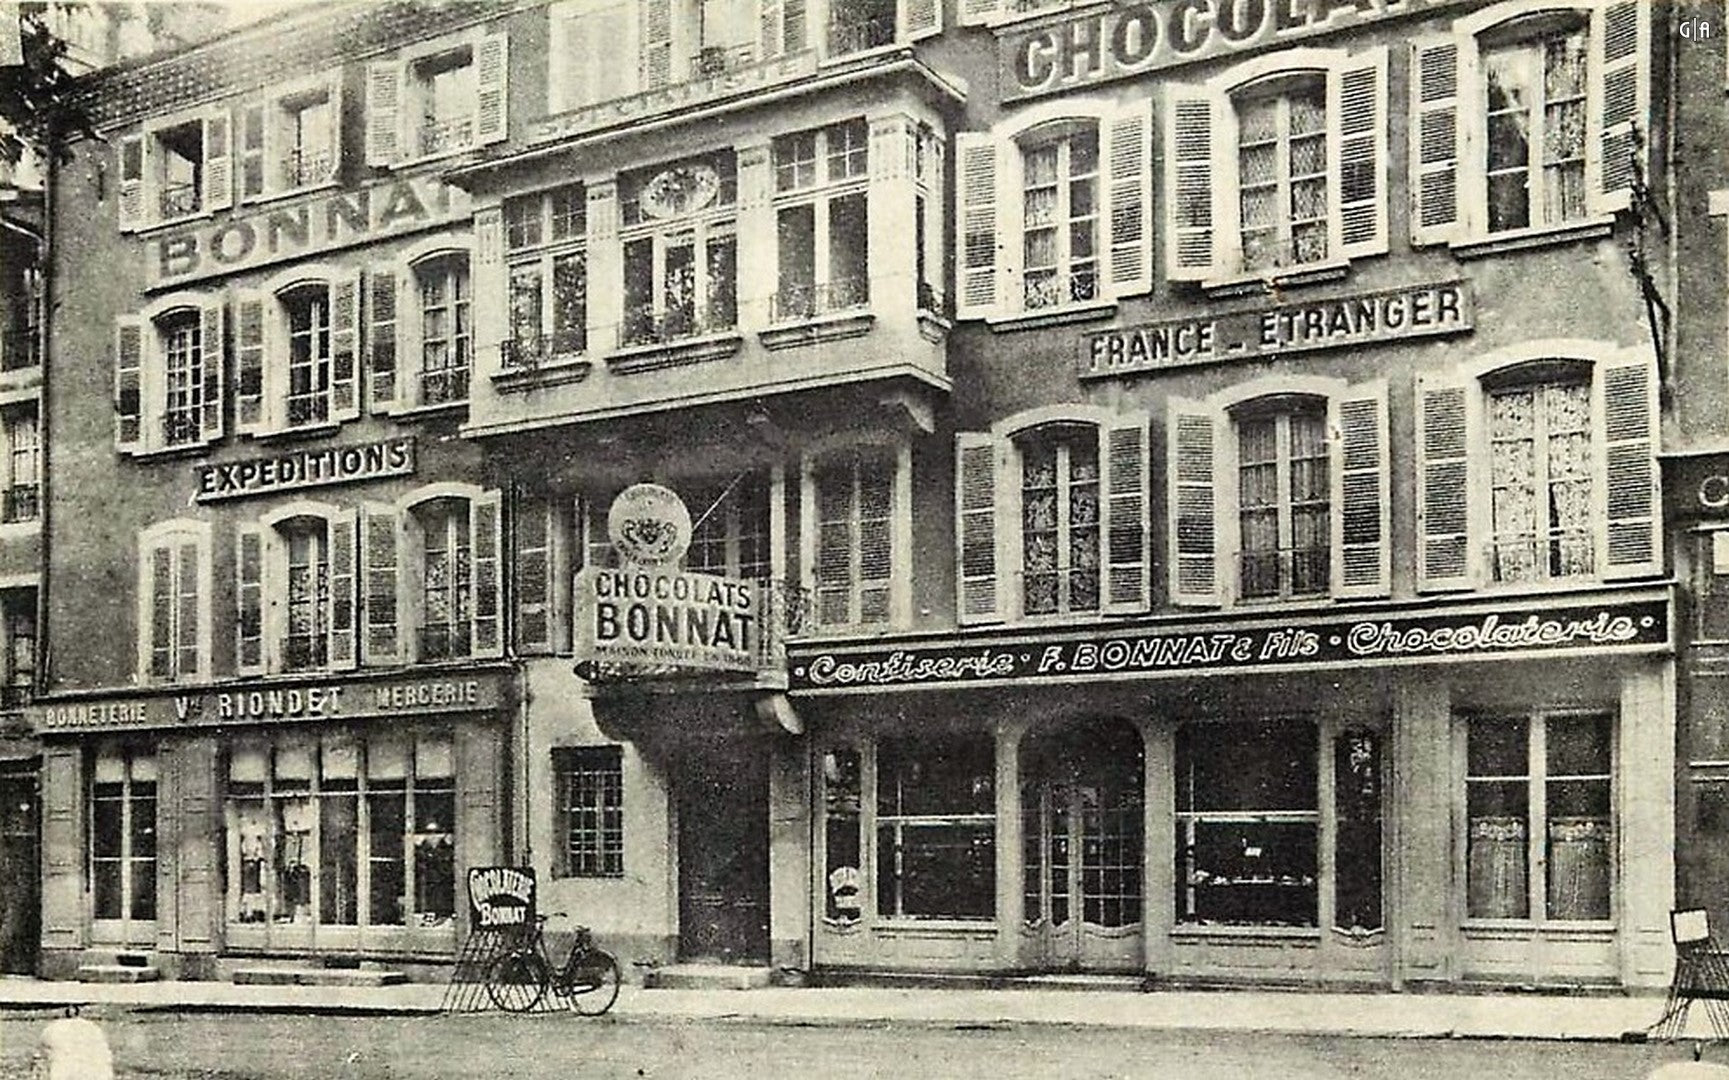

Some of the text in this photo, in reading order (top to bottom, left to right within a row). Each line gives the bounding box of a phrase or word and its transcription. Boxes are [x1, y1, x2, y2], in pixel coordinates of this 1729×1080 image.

[1014, 0, 1403, 89] CHOCOL
[1088, 321, 1217, 373] FRANCE
[200, 441, 410, 494] EXPEDITIONS
[594, 572, 752, 610] CHOCOLATS
[595, 602, 754, 652] BONNAT
[808, 650, 1014, 685] Confiserie
[1037, 645, 1068, 673] F.
[1070, 633, 1236, 671] BONNAT
[1258, 627, 1320, 661] Fils
[1347, 612, 1639, 655] Chocolaterie
[45, 703, 147, 728] BONNETERIE
[218, 686, 342, 720] RIONDET
[376, 680, 480, 711] MERCERIE
